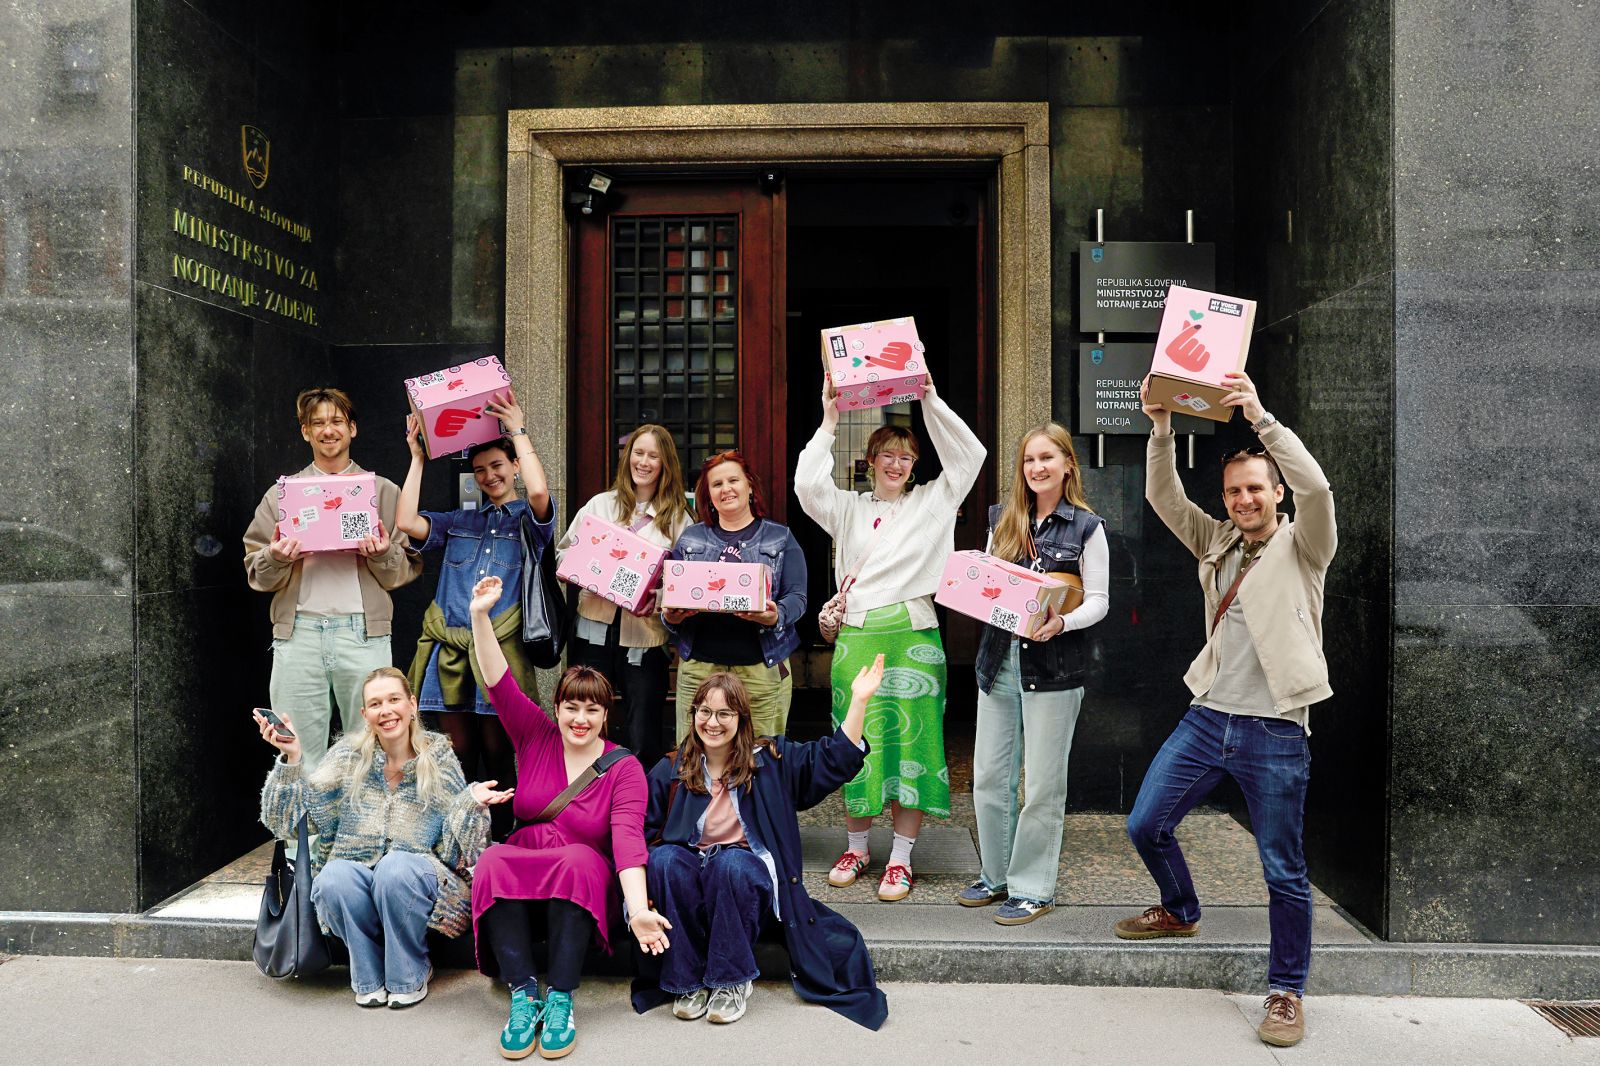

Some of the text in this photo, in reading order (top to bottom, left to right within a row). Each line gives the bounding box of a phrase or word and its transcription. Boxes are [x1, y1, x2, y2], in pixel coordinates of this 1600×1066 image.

[183, 165, 312, 243] REPUBLIKA SLOVENIJA
[174, 208, 318, 291] MINISTRSTVO ZA
[1096, 279, 1142, 287] REPUBLIKA
[173, 253, 318, 326] NOTRANJE ZADEVE
[1096, 289, 1165, 298] MINISTRSTVO ZA
[1096, 300, 1165, 310] NOTRANJE ZADE
[1096, 379, 1142, 388] REPUBLIKA
[1096, 390, 1141, 399] MINISTRST
[1096, 401, 1140, 411] NOTRANJE
[1096, 417, 1131, 427] POLICIJA
